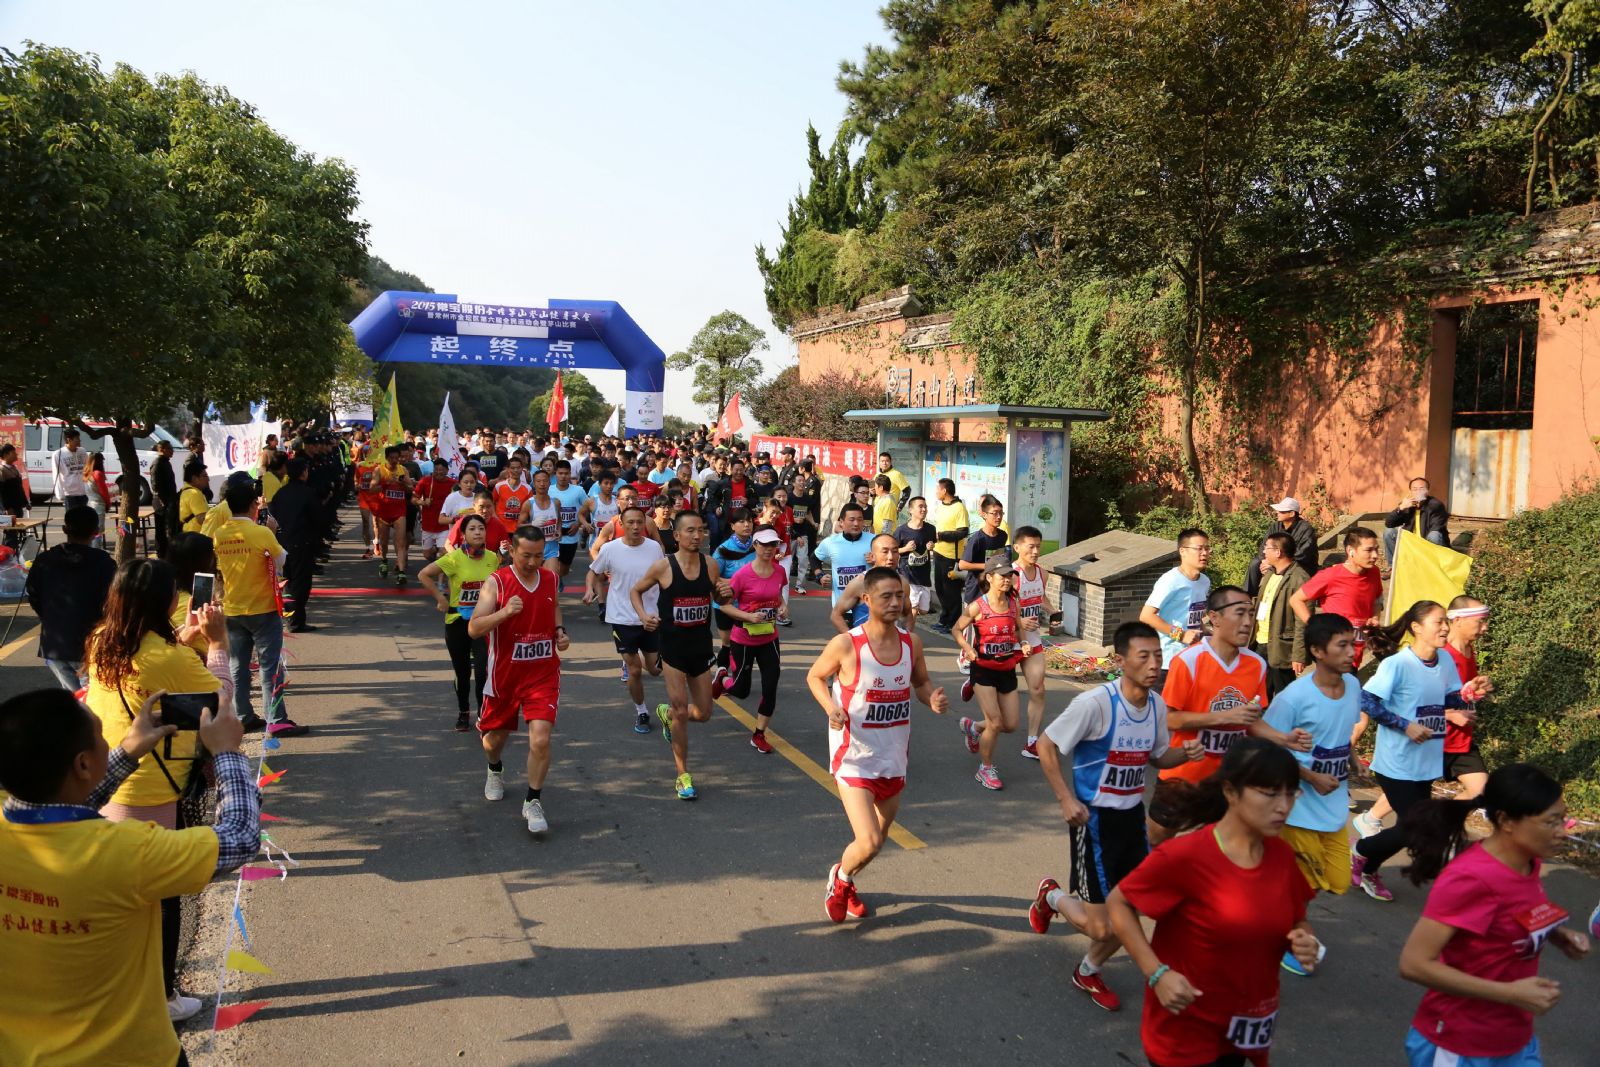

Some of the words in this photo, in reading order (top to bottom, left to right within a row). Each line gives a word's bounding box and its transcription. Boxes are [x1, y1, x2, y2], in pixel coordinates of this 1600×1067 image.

[430, 336, 575, 359] 起终点
[676, 606, 709, 621] A1603
[513, 641, 552, 659] A1302
[873, 675, 906, 688] 跑吧
[865, 701, 910, 722] A0603
